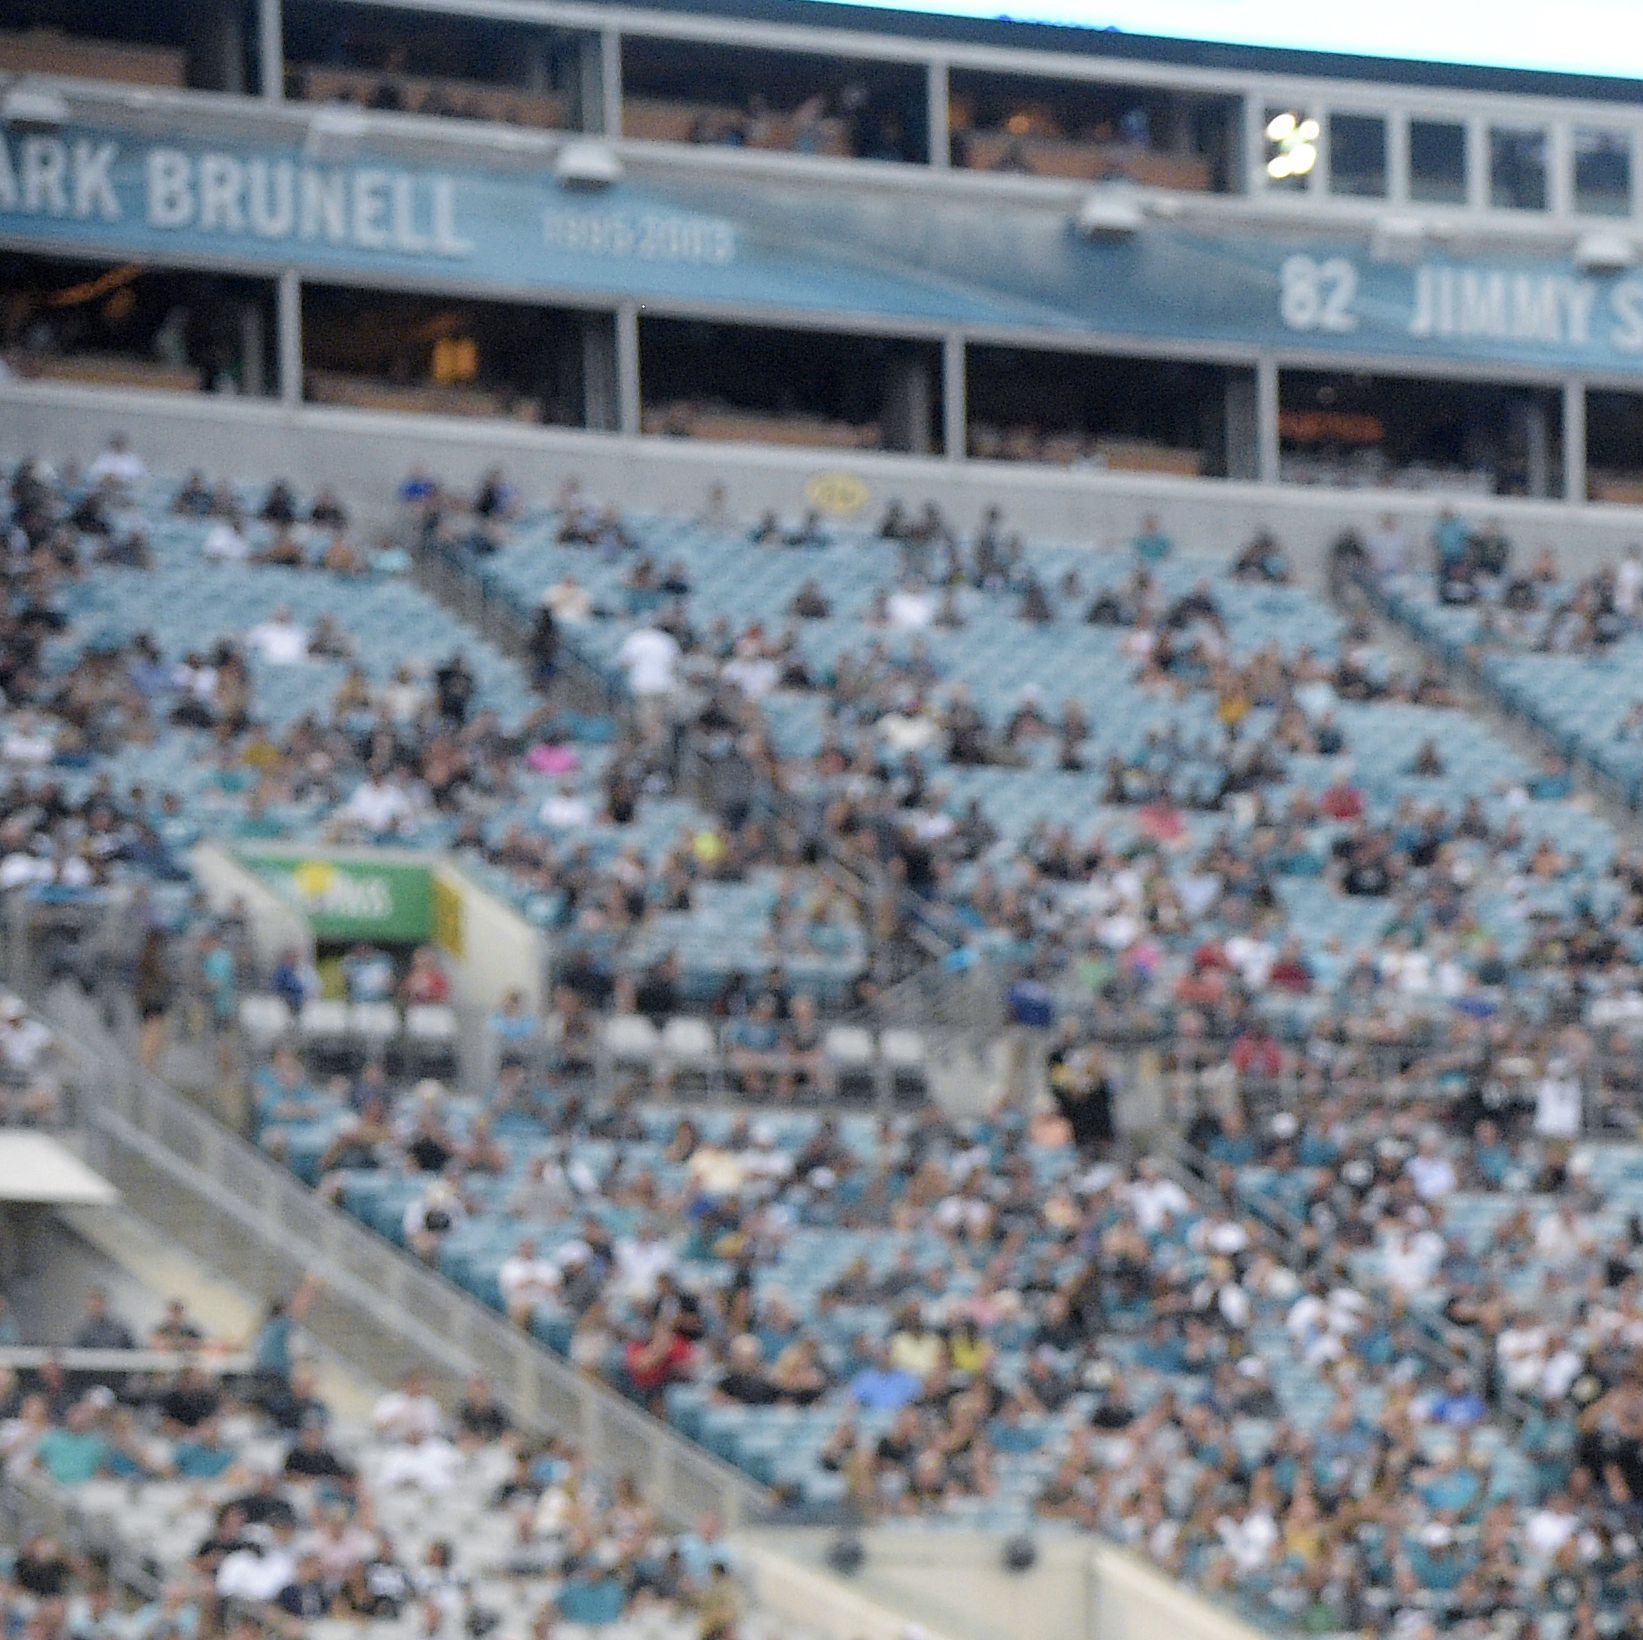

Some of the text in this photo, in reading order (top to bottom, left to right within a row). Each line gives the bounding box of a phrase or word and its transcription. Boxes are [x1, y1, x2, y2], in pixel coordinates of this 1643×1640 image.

[145, 144, 474, 257] BRUNELL
[1280, 254, 1358, 333] 82
[1409, 264, 1597, 344] JIMMY
